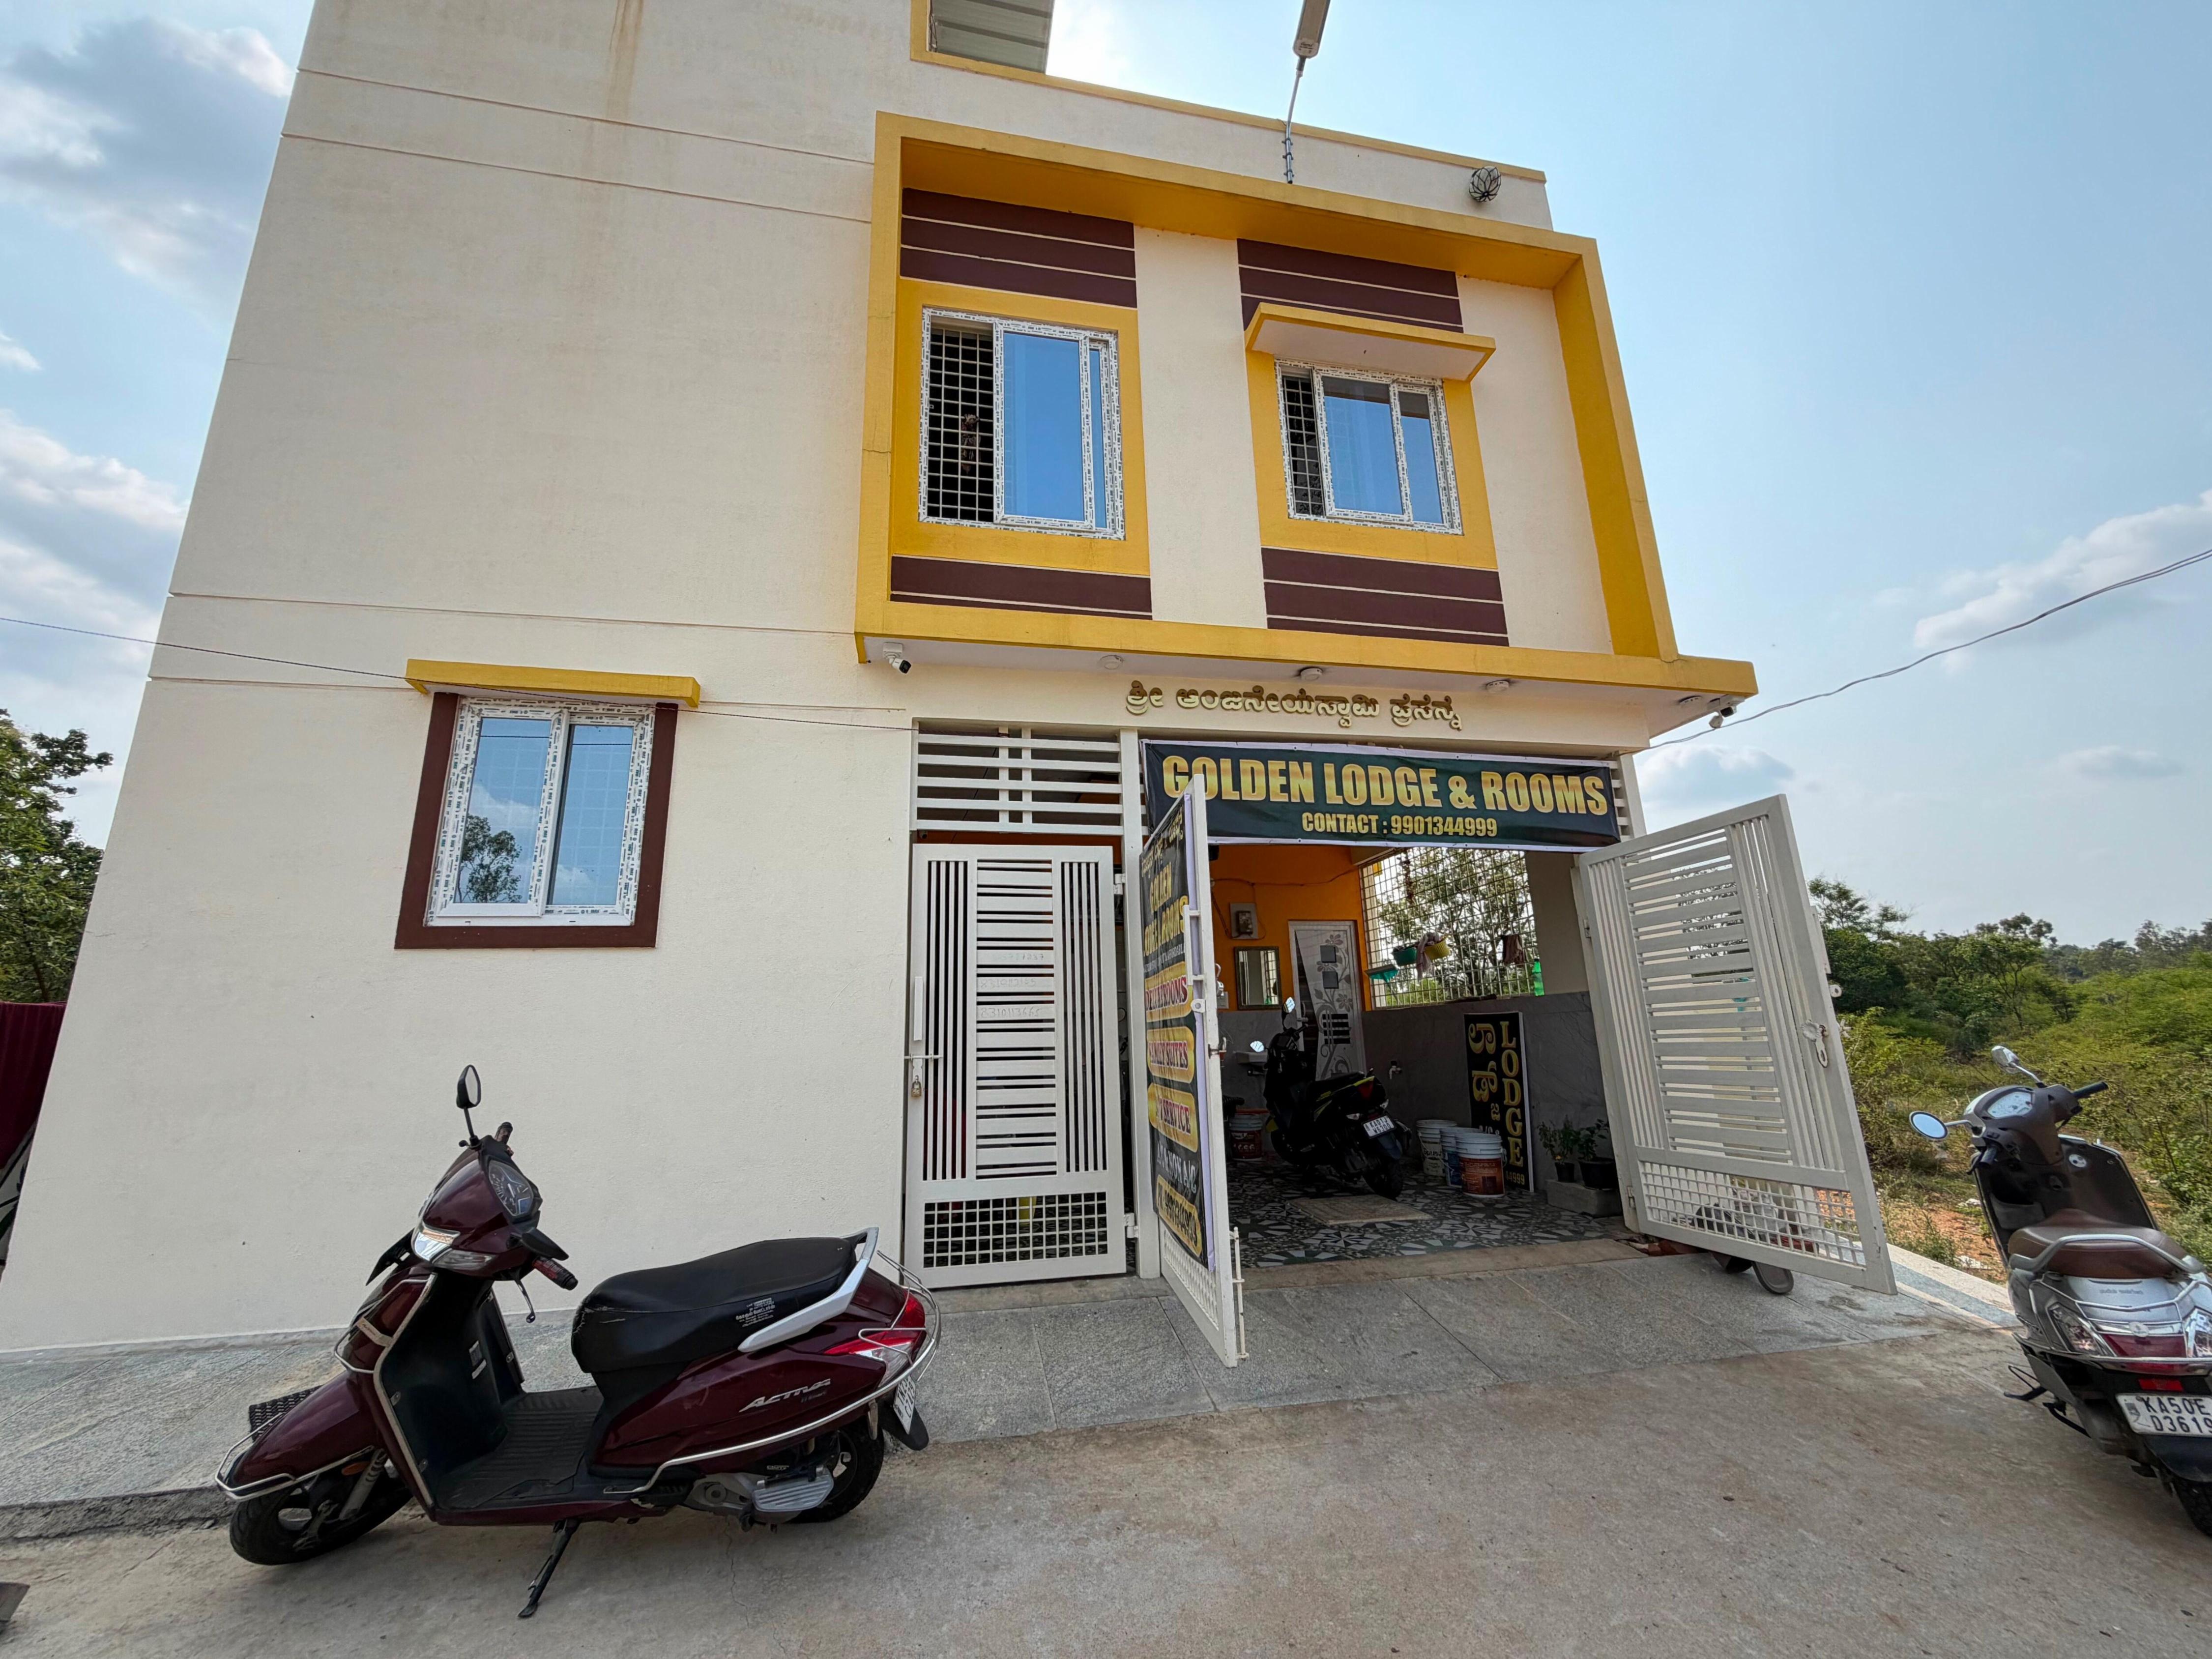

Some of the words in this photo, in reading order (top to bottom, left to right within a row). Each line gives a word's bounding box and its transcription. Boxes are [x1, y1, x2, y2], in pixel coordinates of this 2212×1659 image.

[1126, 680, 1164, 716] ಶ್ರೀ
[1176, 685, 1380, 728] ಆಂಜನೇಯಸ್ವಾಮಿ
[1390, 693, 1463, 731] ಪ್ರಸನ್ನ
[1162, 756, 1315, 803] GOLDEN
[1323, 762, 1443, 808] LODGE
[1448, 775, 1477, 810] &
[1481, 771, 1608, 815] ROOMS
[1302, 812, 1379, 834] CONTACT
[1391, 815, 1498, 837] 9901344999
[1164, 975, 1188, 1009] ROOMS
[1166, 1041, 1188, 1069] SUITES
[1499, 1020, 1523, 1167] LODGE
[1163, 1098, 1191, 1134] SERVICE
[2140, 1397, 2212, 1416] KA50E
[2150, 1415, 2212, 1434] D3619
